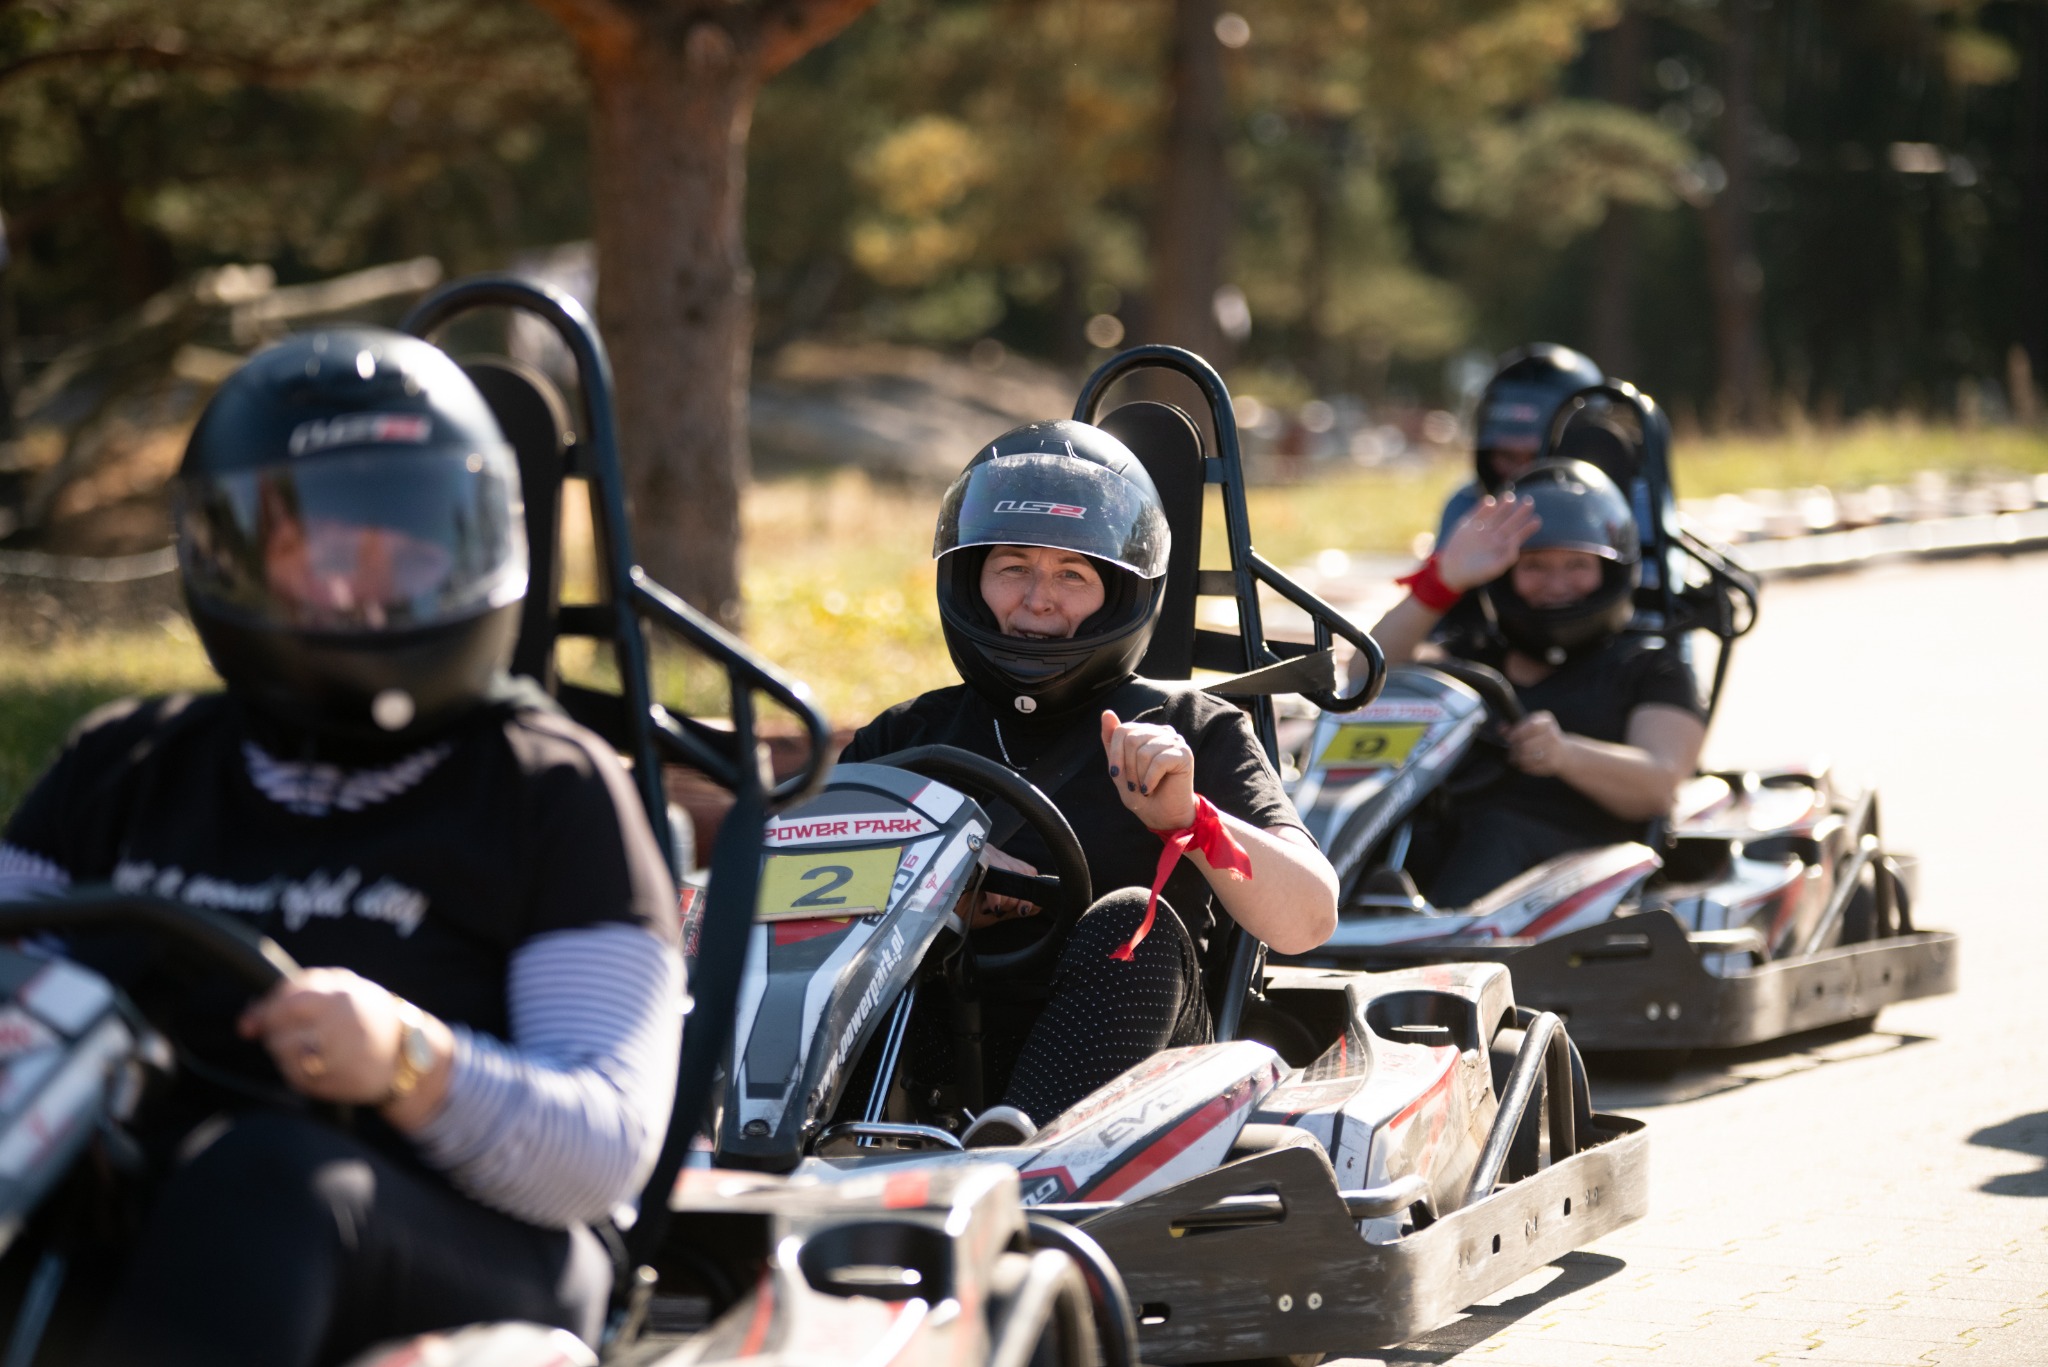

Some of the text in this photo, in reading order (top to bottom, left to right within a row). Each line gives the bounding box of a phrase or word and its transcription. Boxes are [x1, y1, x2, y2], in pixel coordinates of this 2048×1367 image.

[993, 500, 1087, 520] LS2
[1020, 698, 1032, 711] L
[764, 818, 922, 842] POWER PARK
[790, 865, 854, 908] 2
